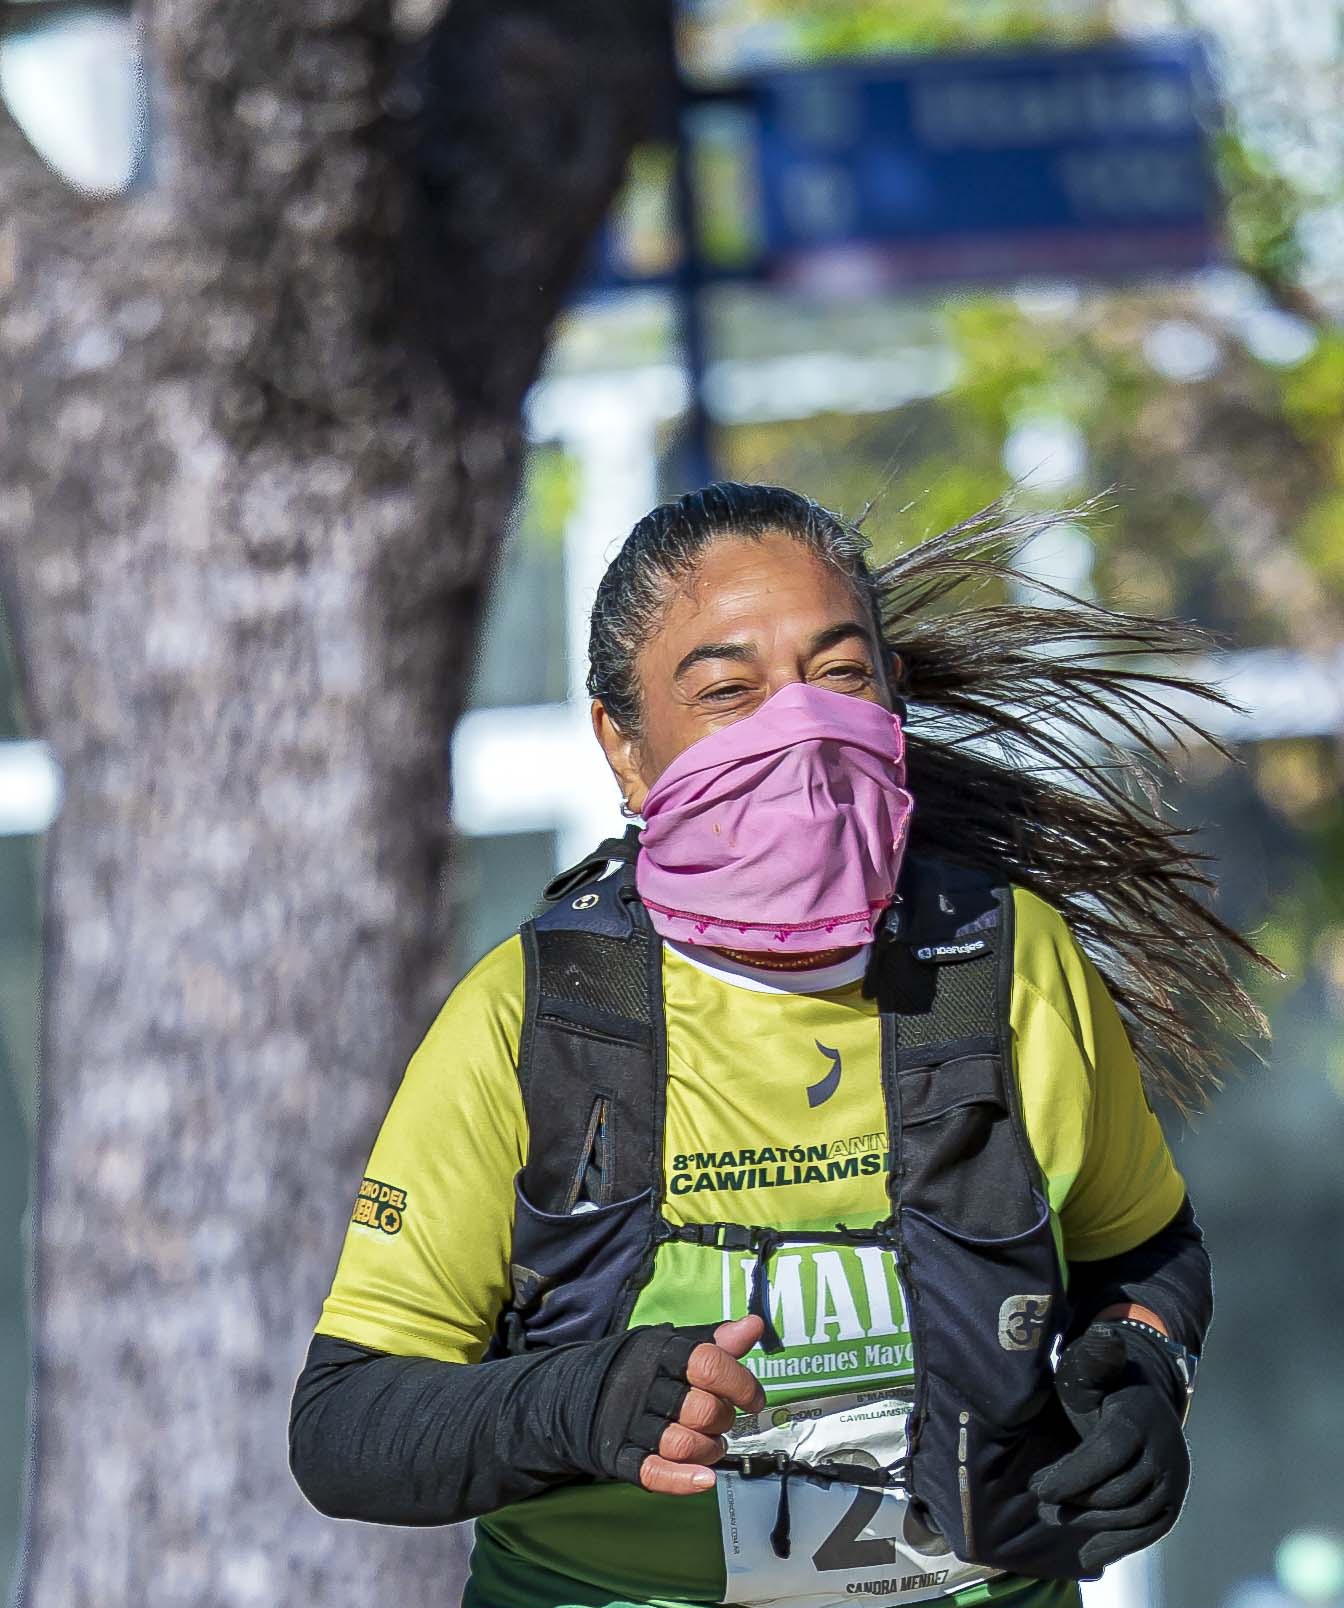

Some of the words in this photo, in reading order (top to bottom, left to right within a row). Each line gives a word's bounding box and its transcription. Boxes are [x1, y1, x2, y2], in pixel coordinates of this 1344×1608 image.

[379, 1186, 405, 1209] DEL
[740, 1246, 912, 1349] MAI
[744, 1351, 858, 1380] Almacenes
[846, 1578, 898, 1596] SANDRA
[900, 1569, 949, 1592] MENDEZ
